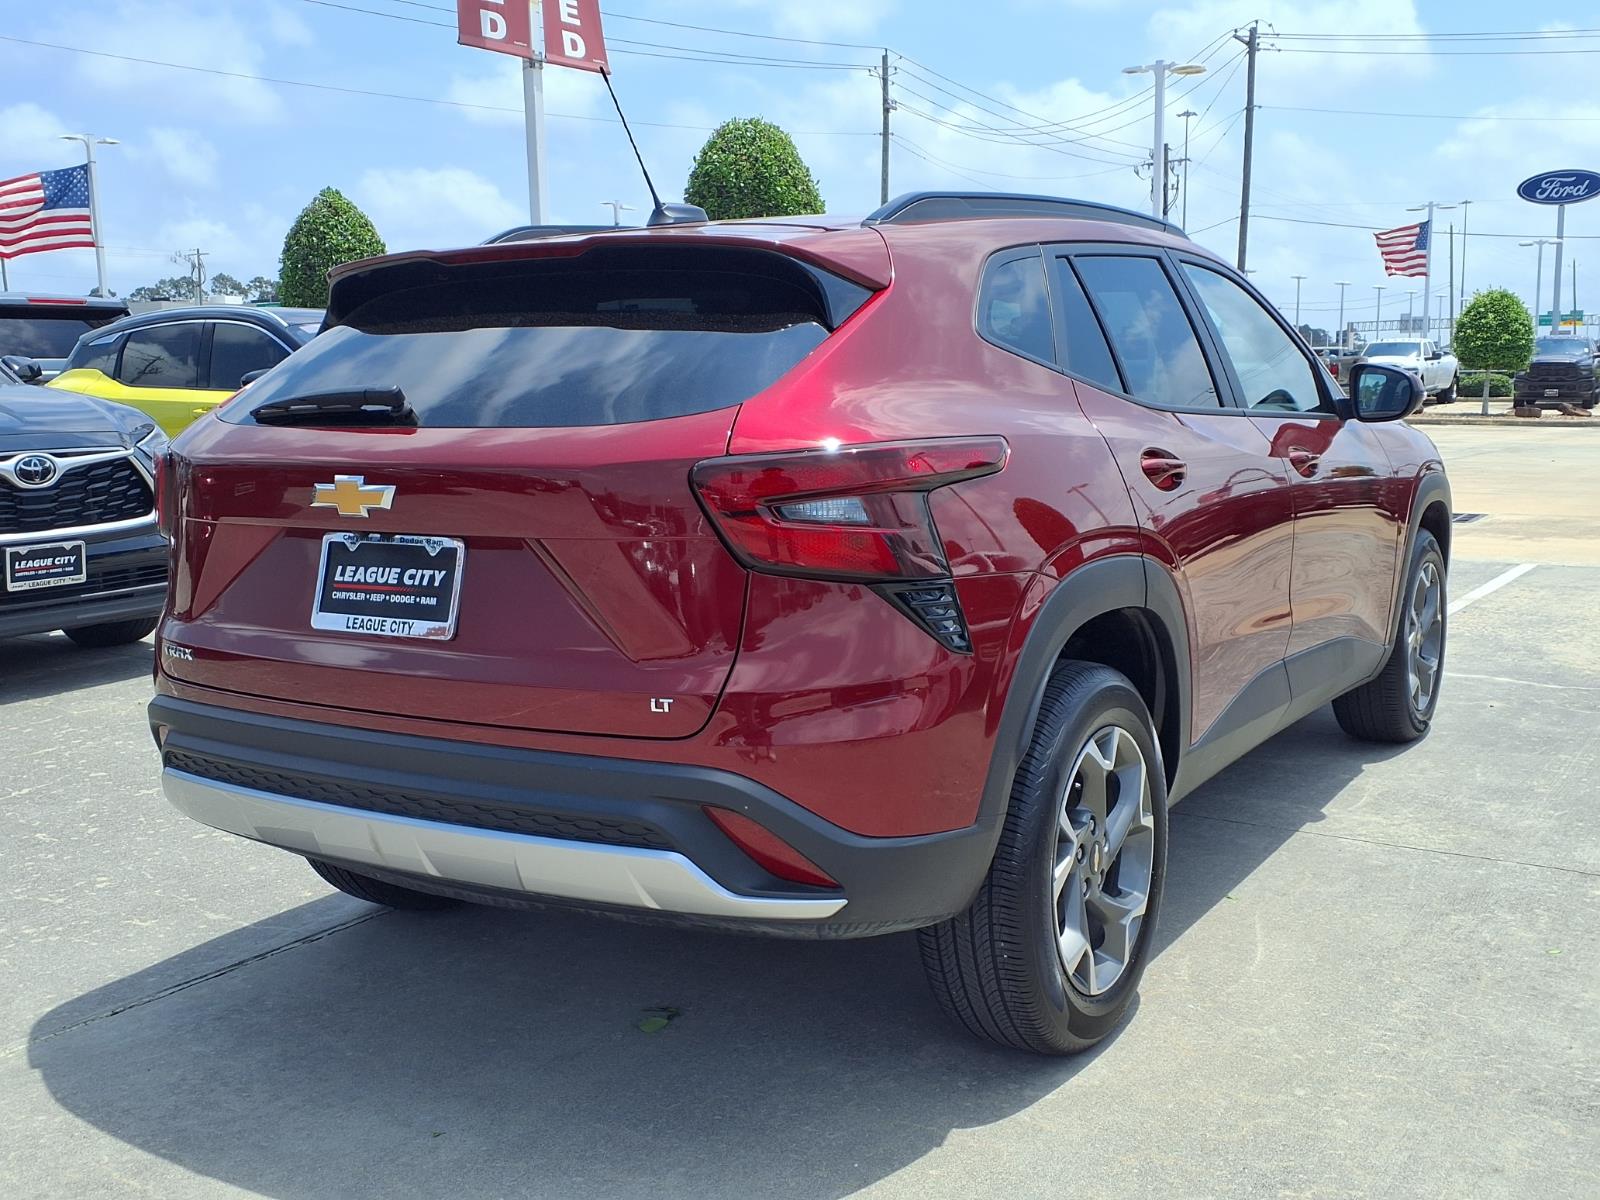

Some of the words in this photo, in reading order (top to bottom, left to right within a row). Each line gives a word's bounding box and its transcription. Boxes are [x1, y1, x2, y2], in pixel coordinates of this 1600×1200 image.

[1536, 176, 1590, 199] Ford
[399, 536, 424, 545] Dodge
[427, 538, 444, 546] Ram
[15, 558, 54, 569] LEAGUE
[54, 556, 77, 564] CITY
[334, 566, 401, 584] LEAGUE
[403, 568, 447, 586] CITY
[28, 580, 52, 588] LEAGUE
[332, 591, 365, 601] CHRYSLER
[370, 593, 385, 602] JEEP
[390, 595, 415, 604] DODGE
[420, 596, 437, 605] RAM
[345, 616, 388, 632] LEAGUE
[389, 621, 415, 636] CITY
[650, 698, 674, 713] LT
